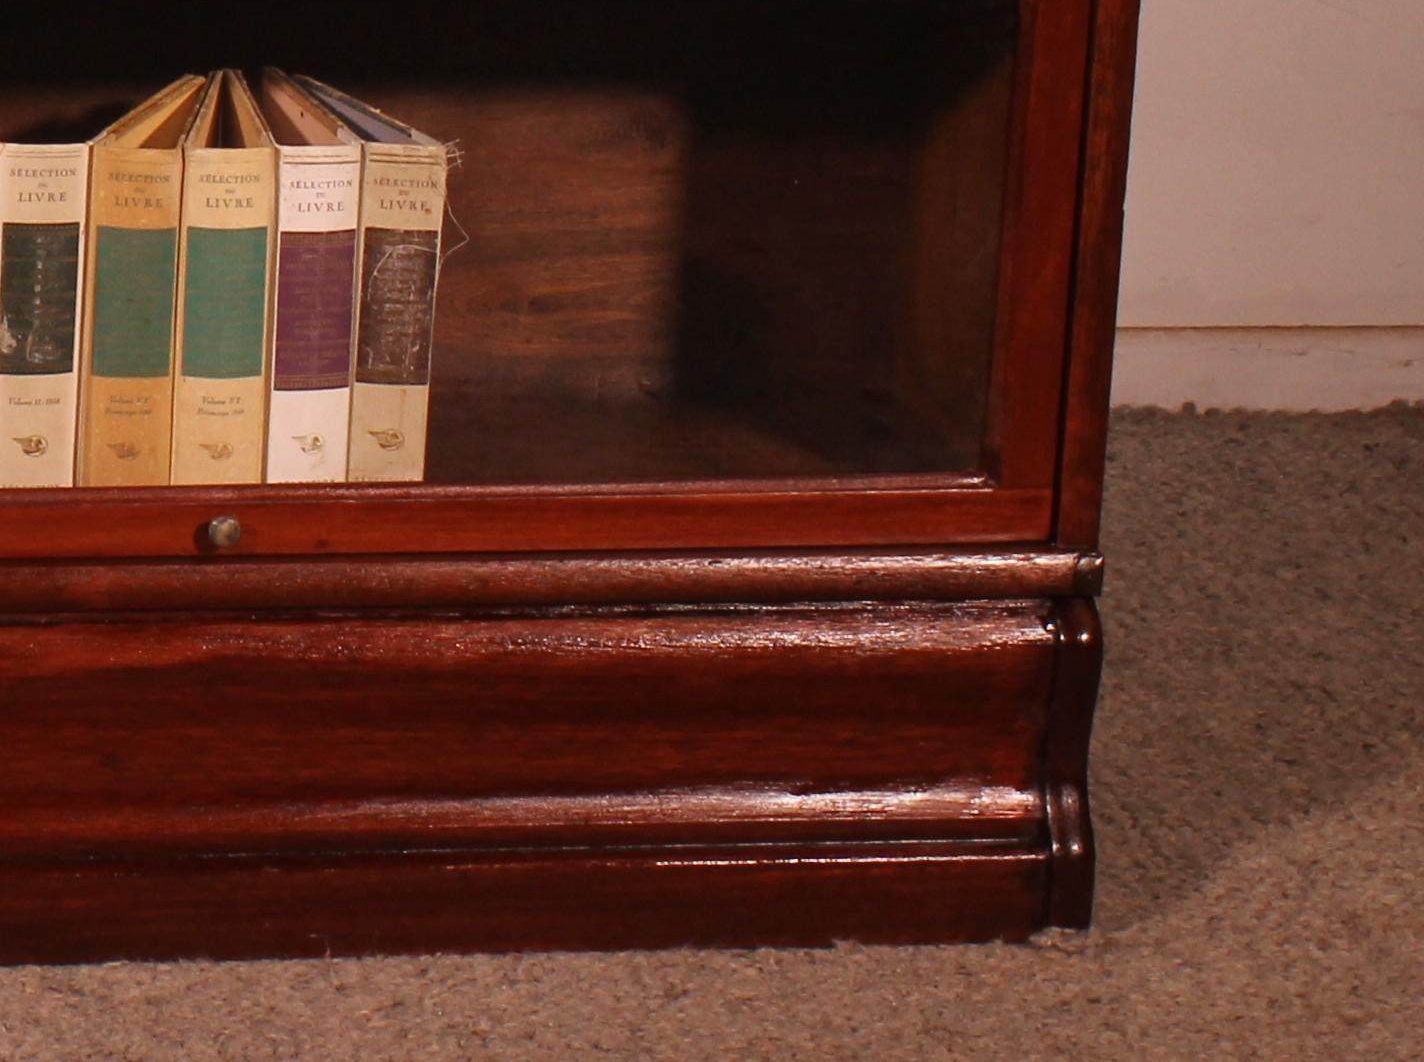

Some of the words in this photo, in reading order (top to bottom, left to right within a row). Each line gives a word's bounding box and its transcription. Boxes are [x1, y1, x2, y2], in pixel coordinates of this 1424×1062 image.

[9, 167, 78, 179] SÉLECTION
[199, 174, 261, 185] SÉLECTION
[289, 179, 353, 190] SÉLECTION
[372, 177, 439, 189] SÉLECTION
[17, 191, 69, 204] LIVRE
[114, 195, 164, 209] LIVRE
[204, 196, 255, 209] LIVRE
[297, 201, 345, 214] LIVRE
[379, 199, 428, 212] LIVRE
